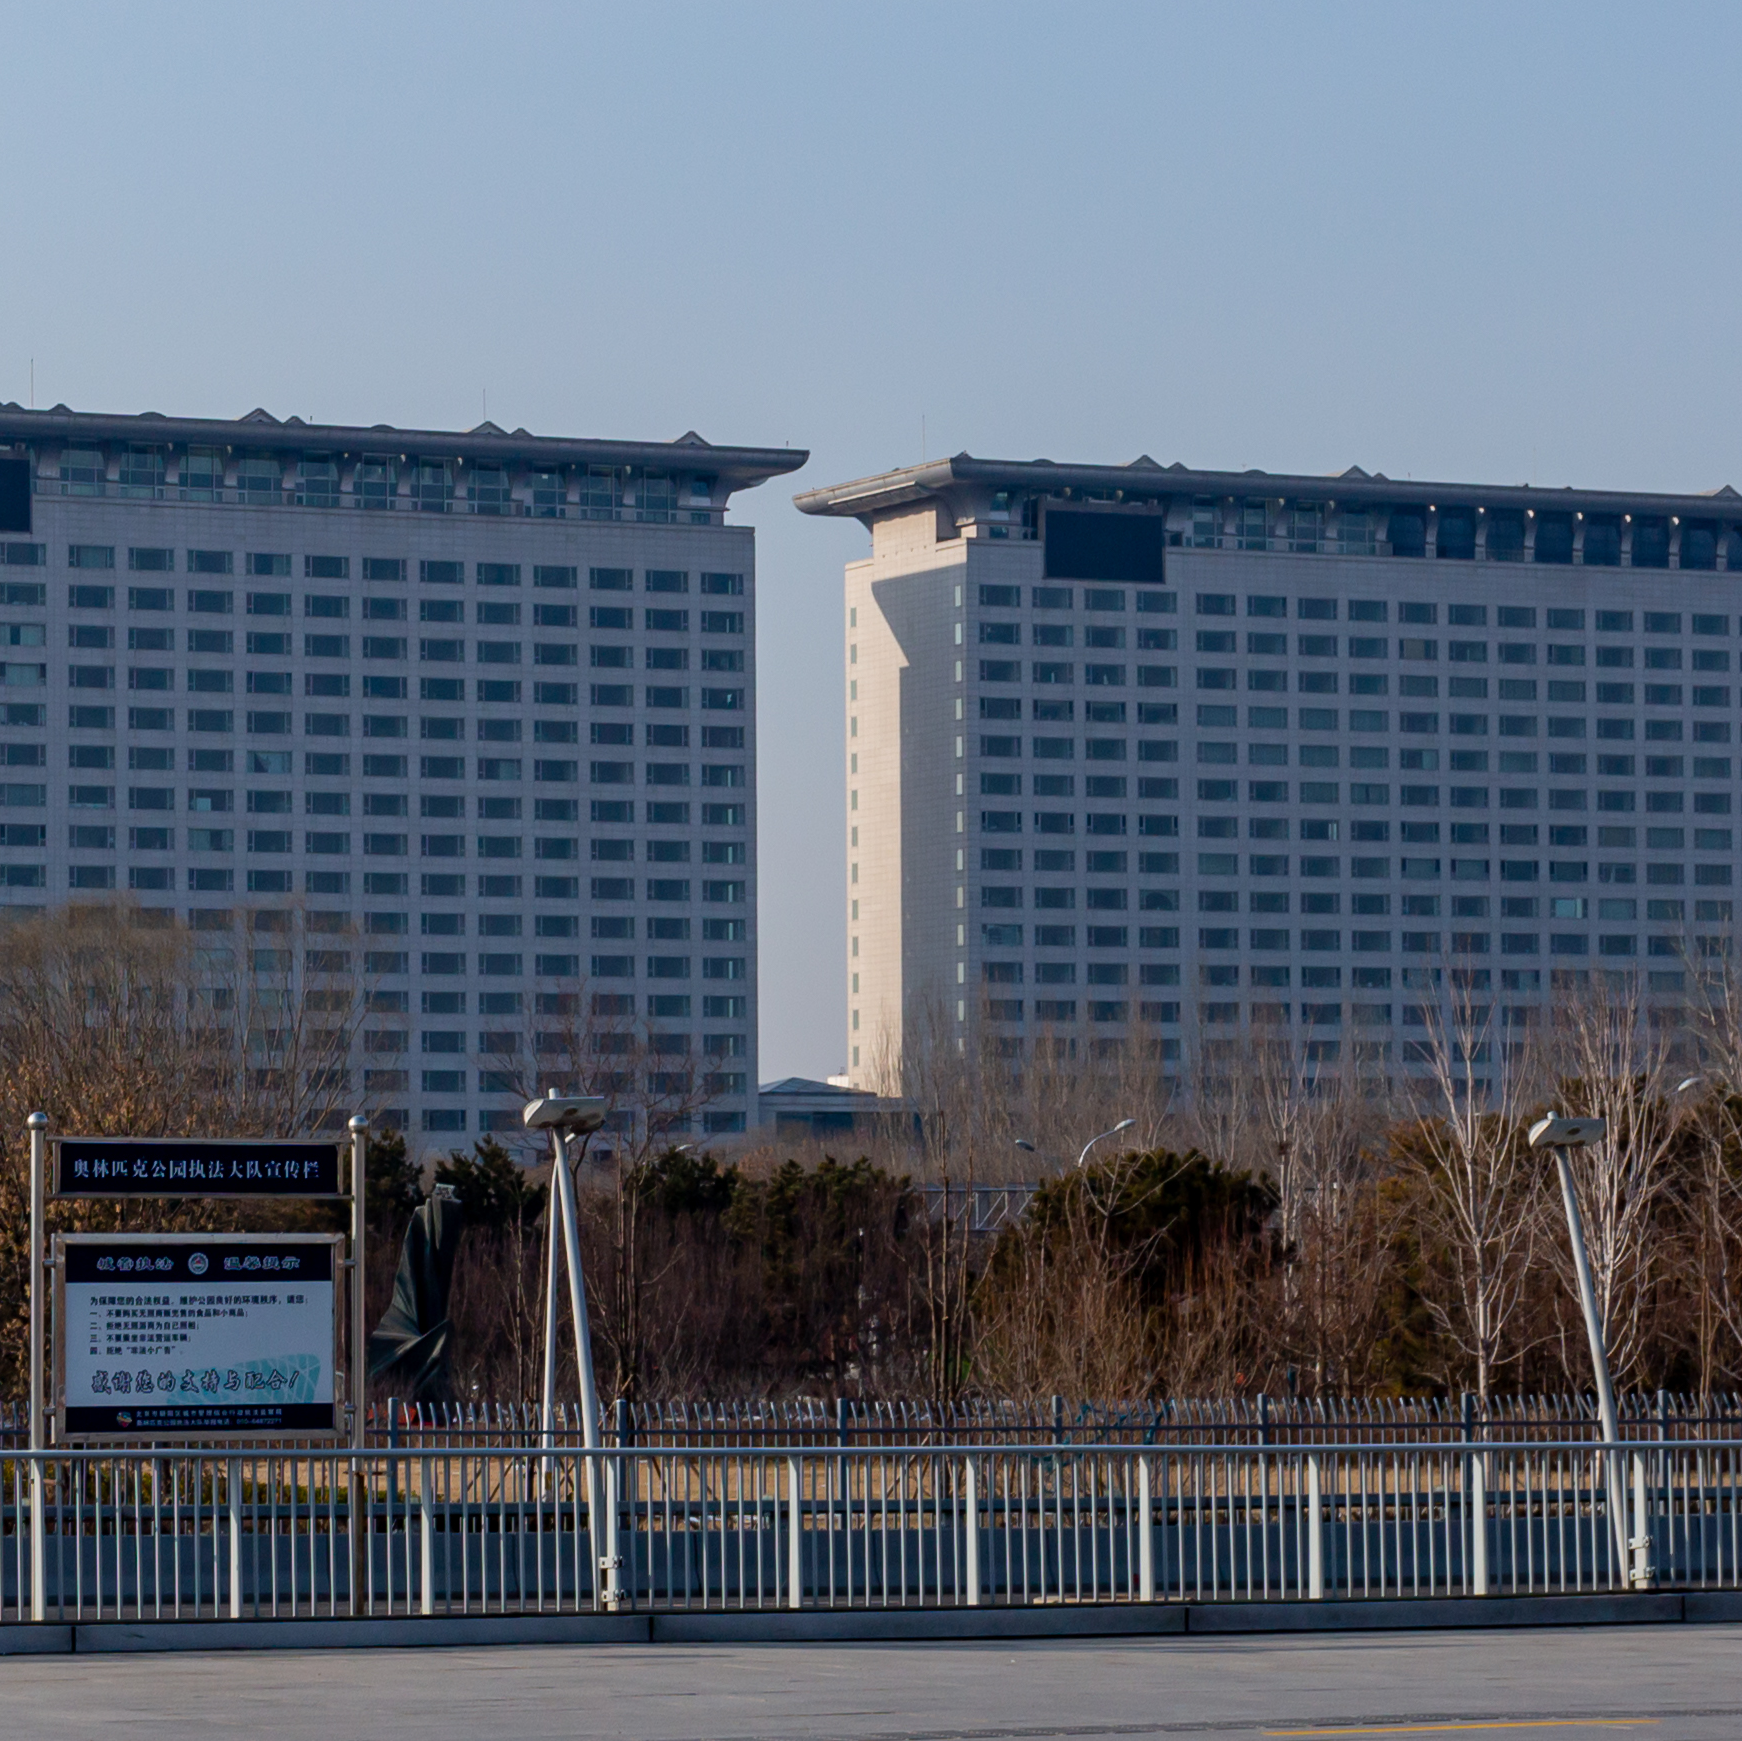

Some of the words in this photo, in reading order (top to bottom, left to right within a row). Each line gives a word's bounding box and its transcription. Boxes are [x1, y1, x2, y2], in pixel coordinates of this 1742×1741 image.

[74, 1159, 319, 1178] 奥林匹克公园执法大队宣传栏
[97, 1257, 174, 1271] 城管执法
[224, 1256, 301, 1270] 温馨提示
